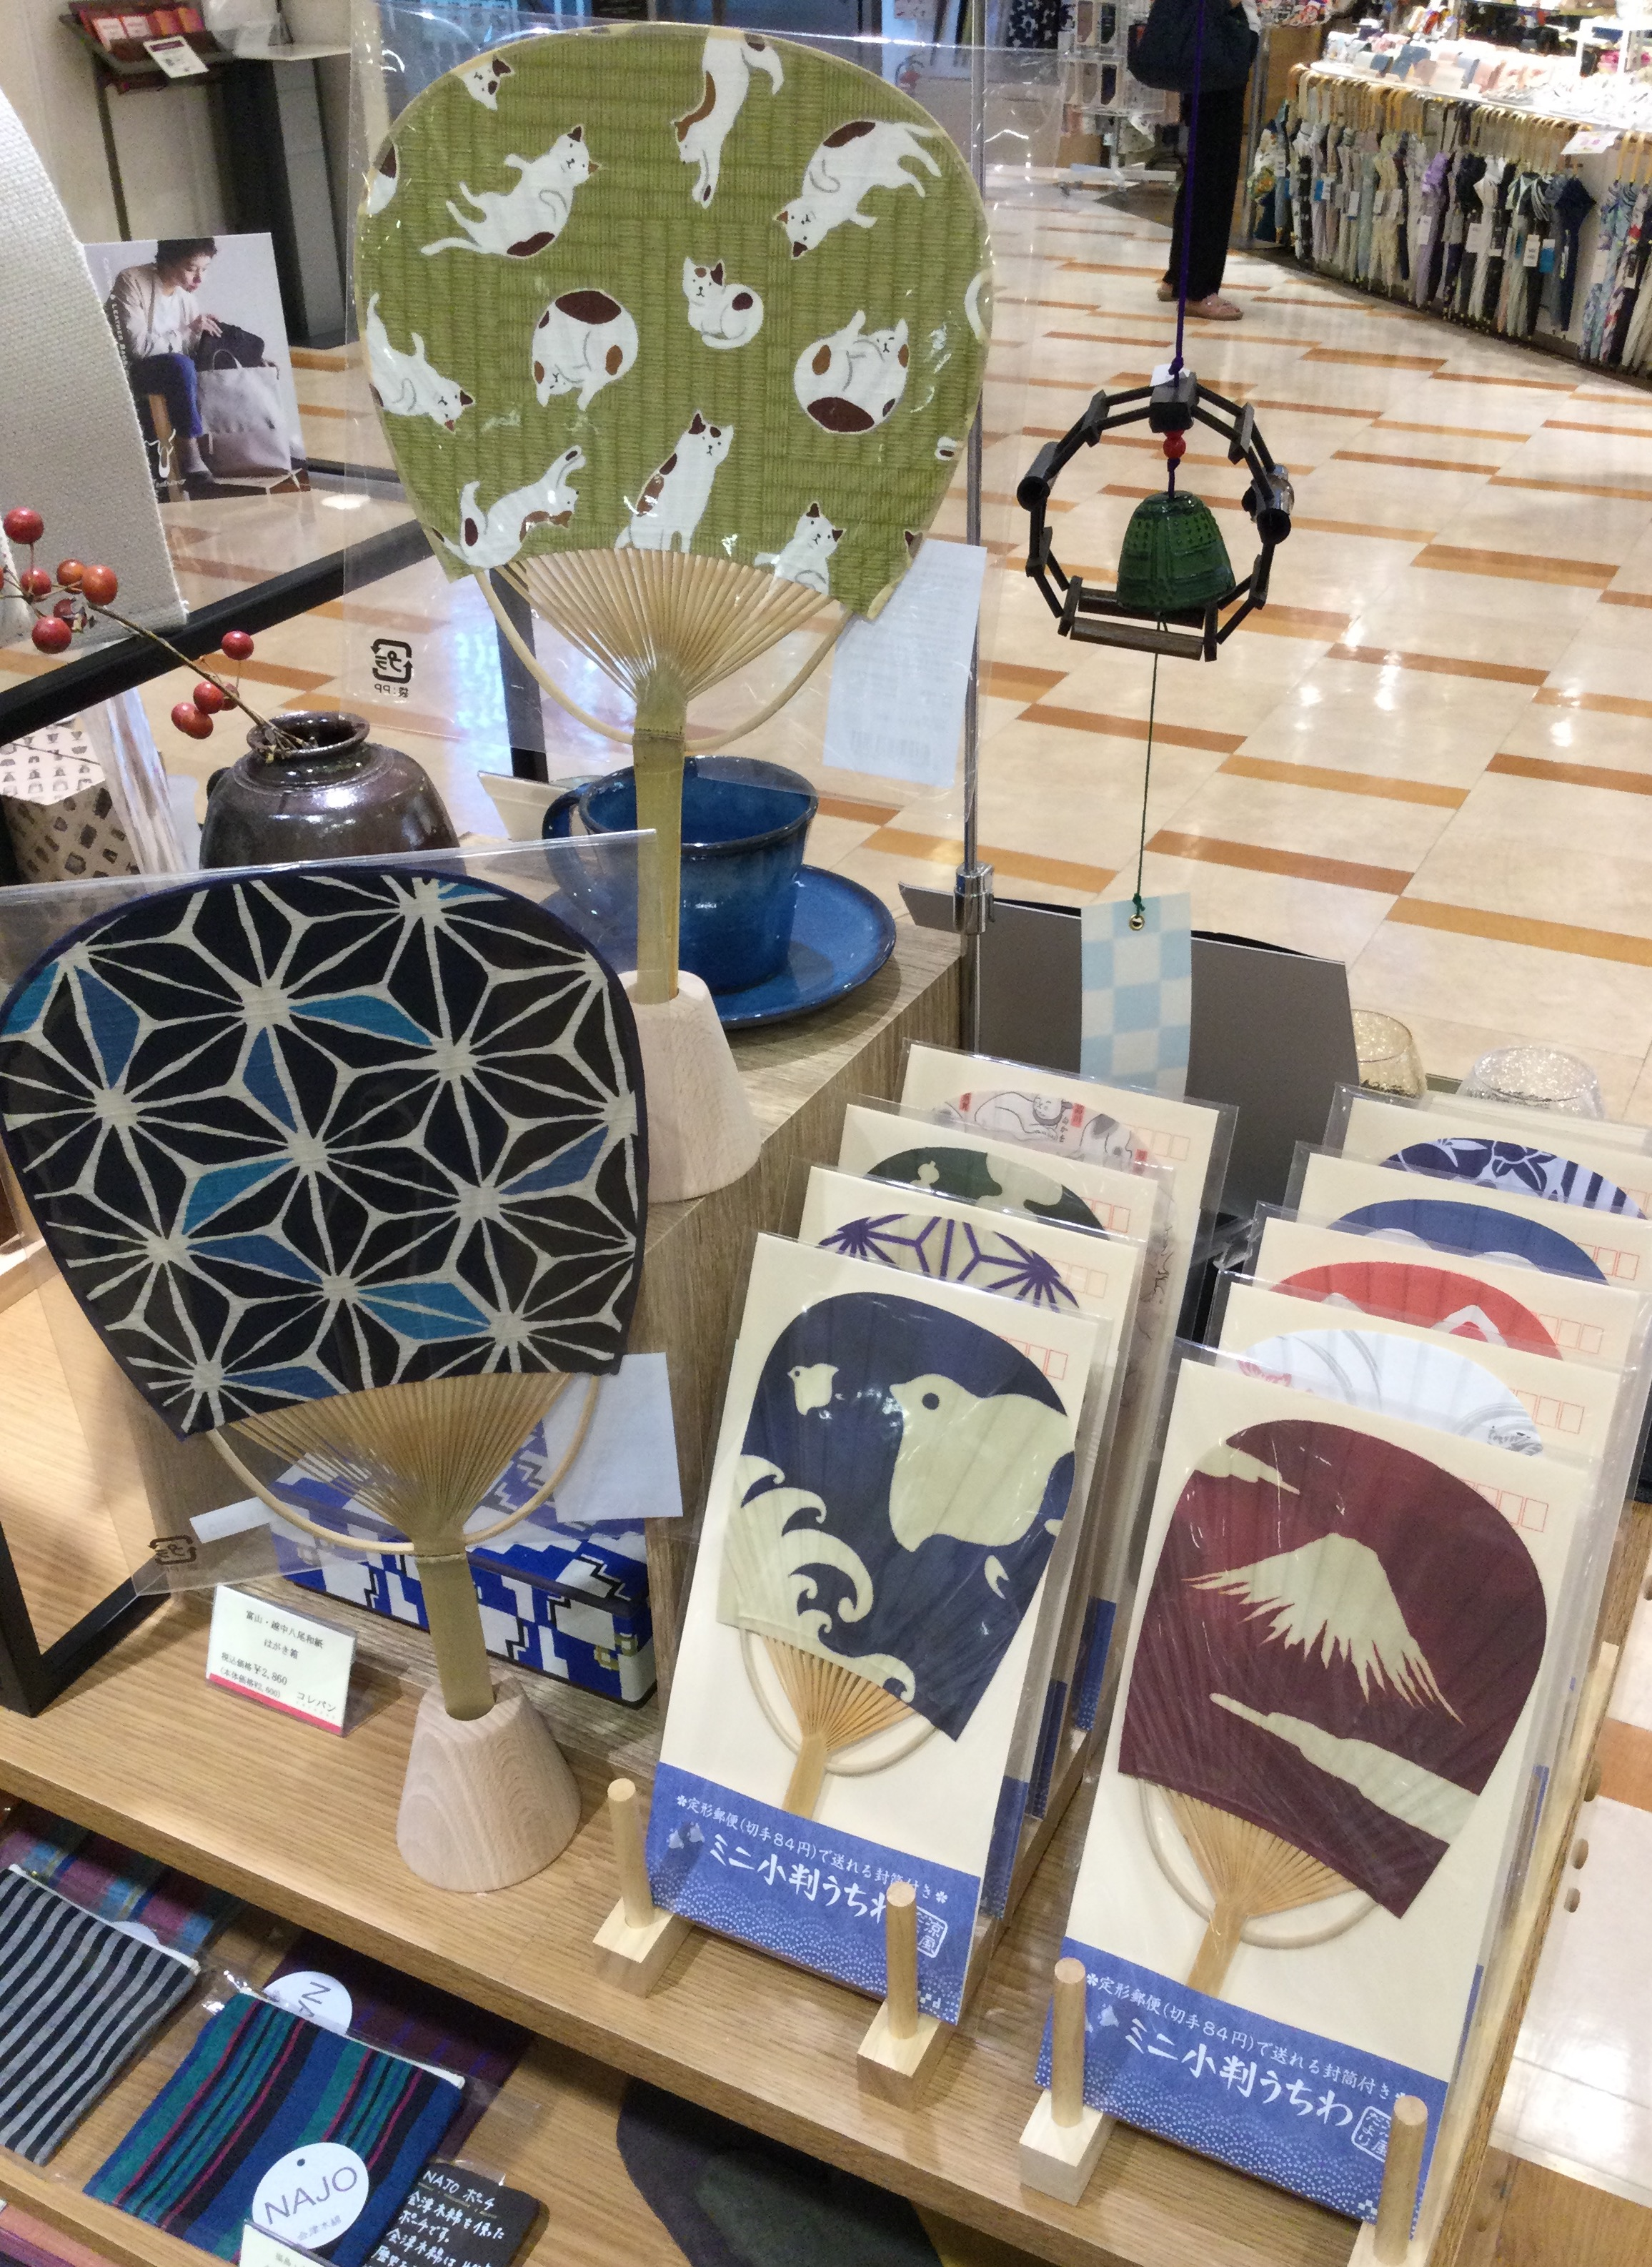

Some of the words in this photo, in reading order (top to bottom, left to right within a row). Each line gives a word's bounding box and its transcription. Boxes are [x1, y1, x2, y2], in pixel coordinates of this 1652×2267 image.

[1125, 2018, 1353, 2126] ミニ小判うちわ
[264, 2166, 358, 2225] NAJO
[423, 2171, 459, 2194] NAJO
[463, 2188, 495, 2211] ポーチ
